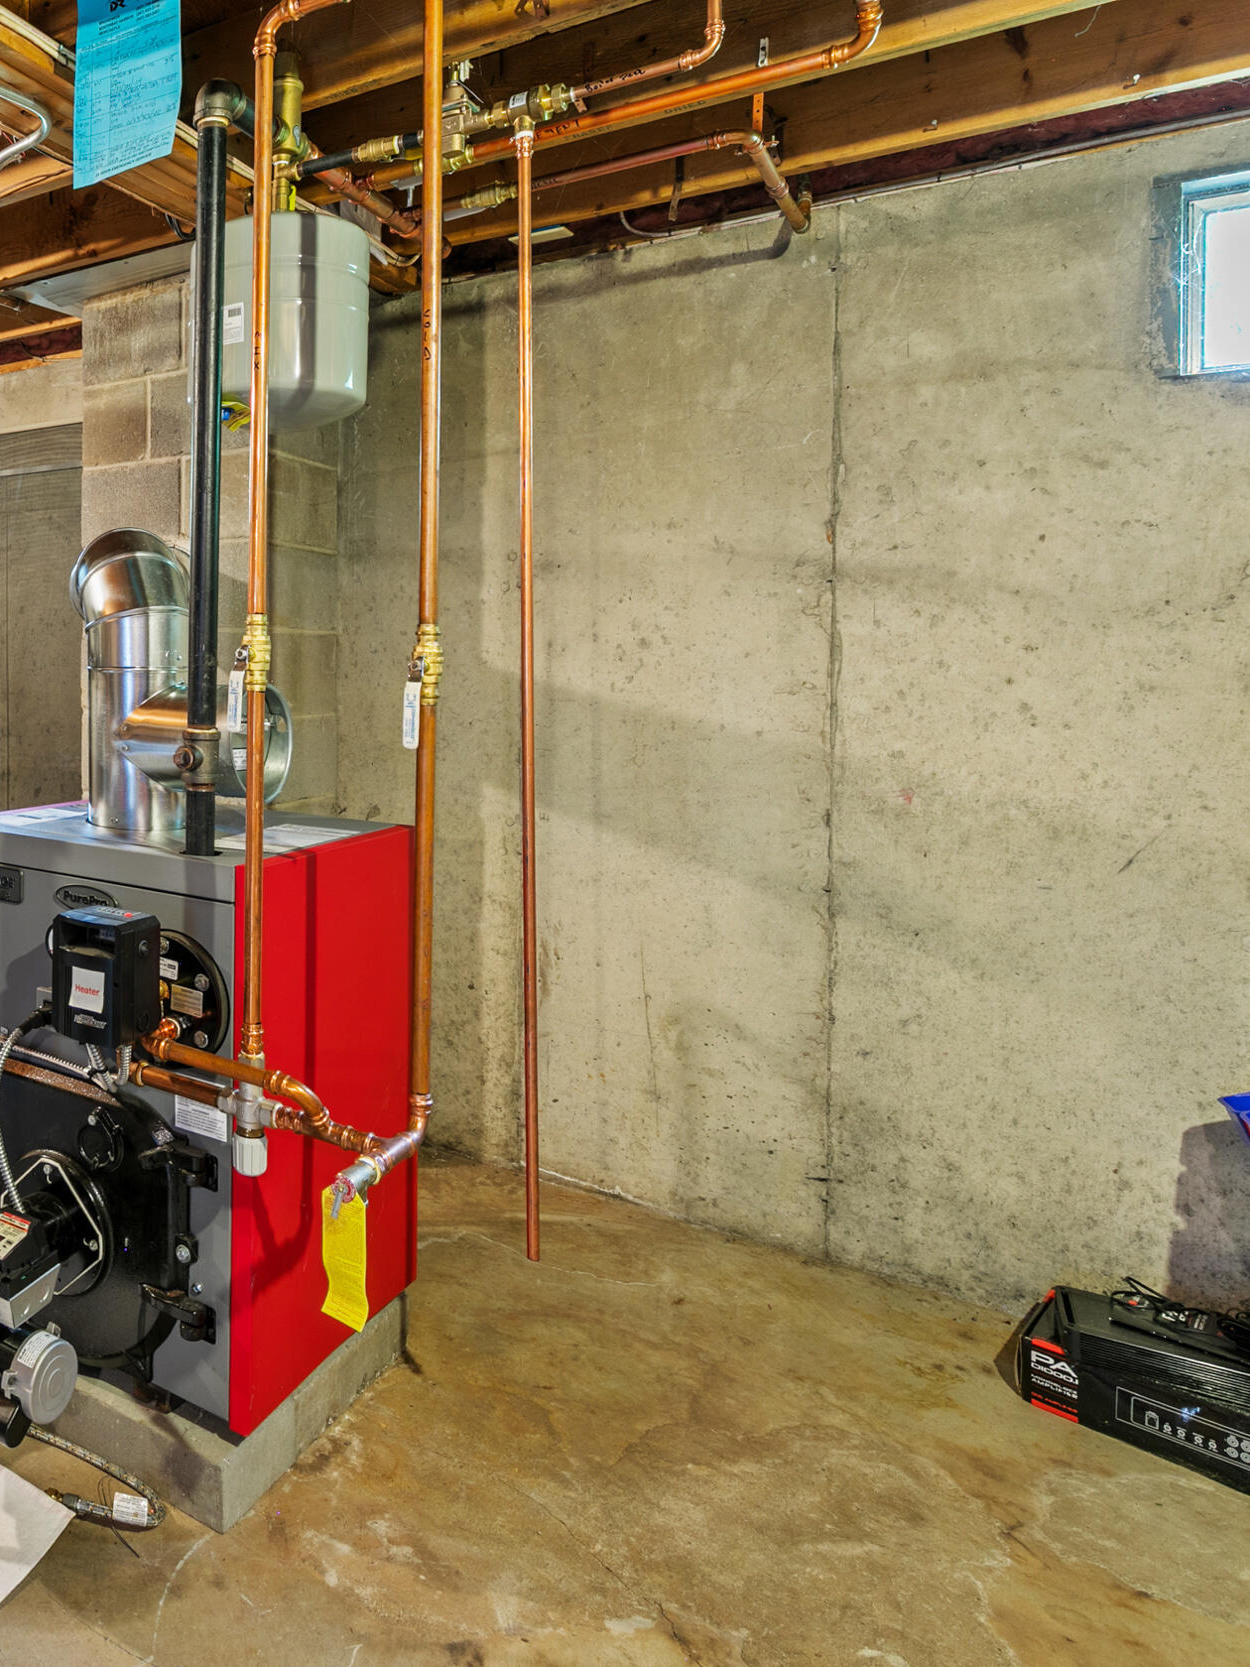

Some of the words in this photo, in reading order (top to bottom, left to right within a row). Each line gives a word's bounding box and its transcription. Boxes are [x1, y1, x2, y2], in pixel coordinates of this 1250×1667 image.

[63, 890, 109, 907] PurePro
[75, 984, 100, 997] Heater
[1031, 1350, 1079, 1378] PA
